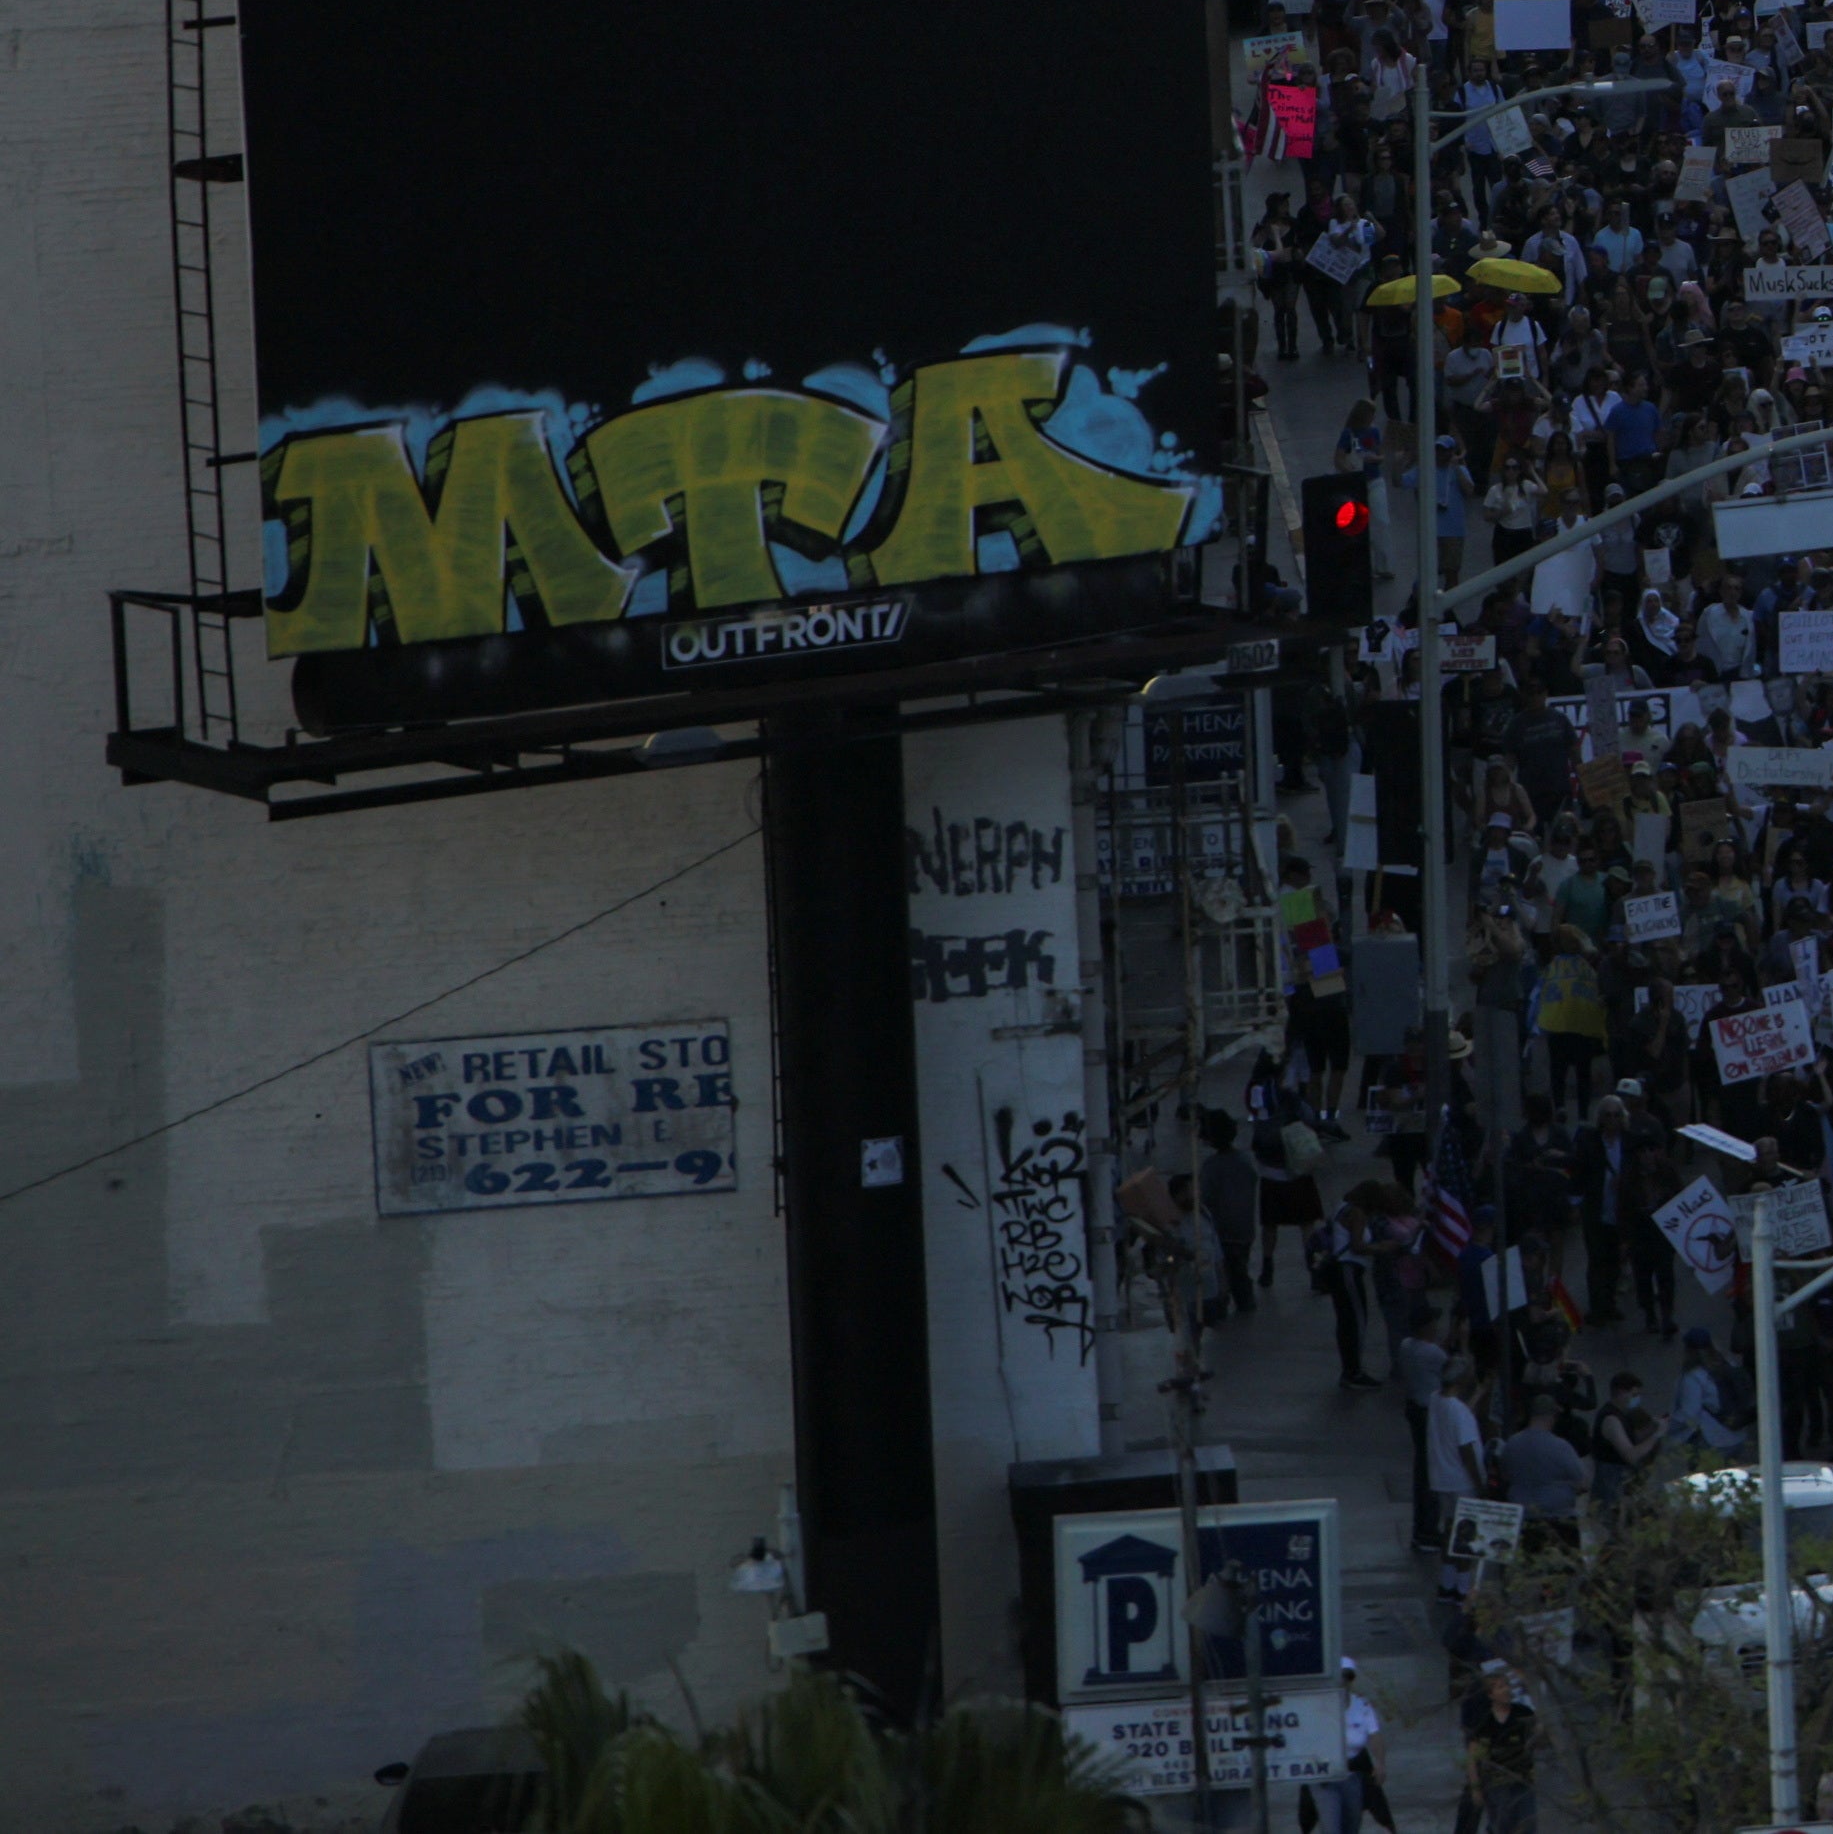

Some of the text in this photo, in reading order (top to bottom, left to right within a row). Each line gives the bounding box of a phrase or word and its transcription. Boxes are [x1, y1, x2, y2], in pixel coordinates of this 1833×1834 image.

[1750, 271, 1795, 293] Musk
[264, 348, 1200, 657] MTA
[463, 1045, 615, 1084] RETAIL
[413, 1085, 587, 1128] FOR
[419, 1120, 622, 1158] STEPHEN
[1107, 1576, 1158, 1672] P
[1113, 1720, 1180, 1740] STATE
[1127, 1741, 1168, 1758] 320
